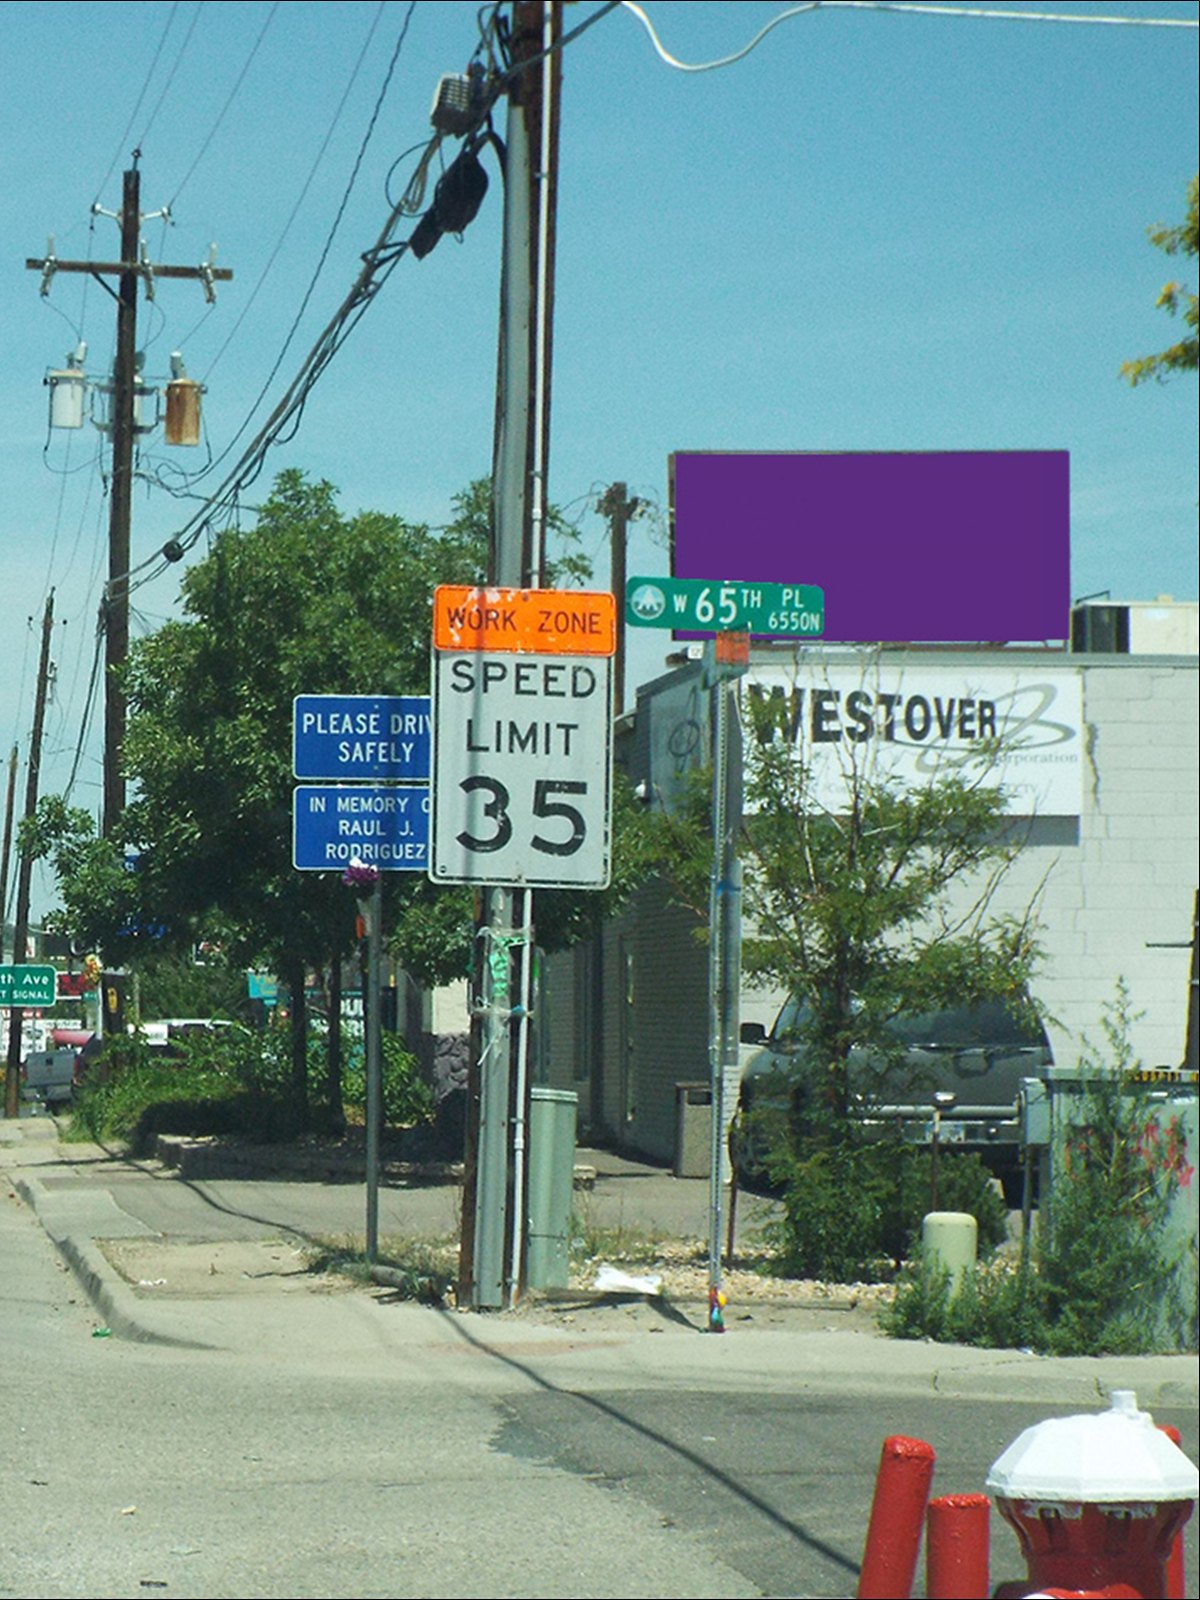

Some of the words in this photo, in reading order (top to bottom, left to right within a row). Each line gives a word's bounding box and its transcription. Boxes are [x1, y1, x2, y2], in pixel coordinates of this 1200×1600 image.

[673, 594, 687, 613] W
[782, 588, 805, 608] PL
[446, 607, 518, 631] WORK
[537, 610, 603, 635] ZONE
[768, 612, 820, 631] 6550N
[450, 659, 596, 698] SPEED
[303, 713, 380, 735] PLEASE
[390, 714, 431, 735] DRIV
[747, 684, 997, 744] WESTOVER
[466, 719, 579, 756] LIMIT
[338, 741, 415, 763] SAFELY
[985, 749, 1078, 766] orporation
[310, 797, 326, 812] IN
[337, 797, 409, 813] MEMORY
[455, 775, 588, 857] 35
[339, 820, 387, 836] RAUL
[399, 821, 414, 836] J.
[326, 843, 426, 860] RODRIGUEZ
[22, 974, 49, 985] Ave
[12, 990, 50, 999] SIGNAL
